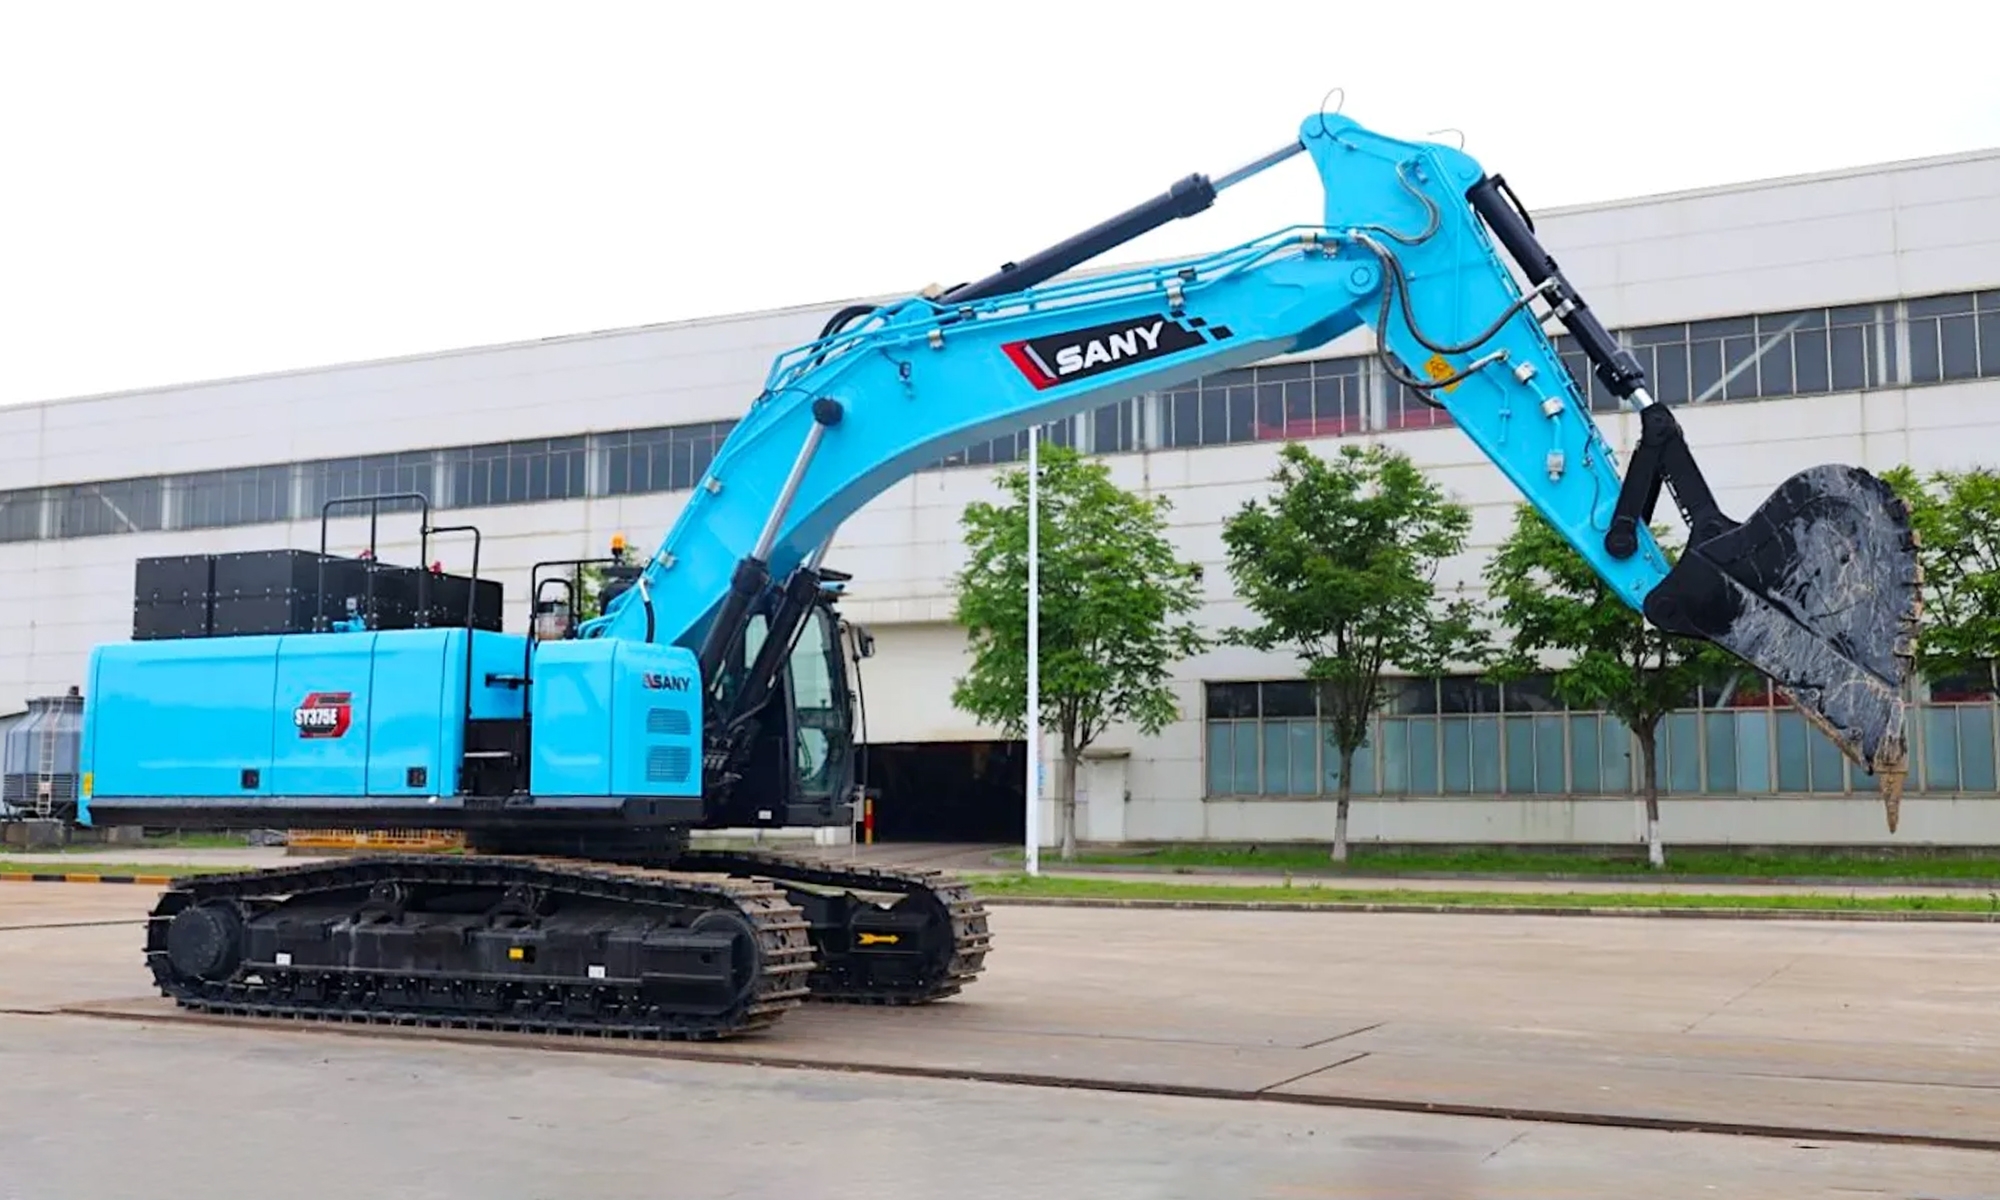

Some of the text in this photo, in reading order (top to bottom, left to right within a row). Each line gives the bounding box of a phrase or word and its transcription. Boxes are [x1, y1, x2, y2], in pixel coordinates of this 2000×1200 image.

[1055, 320, 1164, 377] SANY
[653, 674, 691, 692] SANY
[294, 708, 338, 726] SY375E
